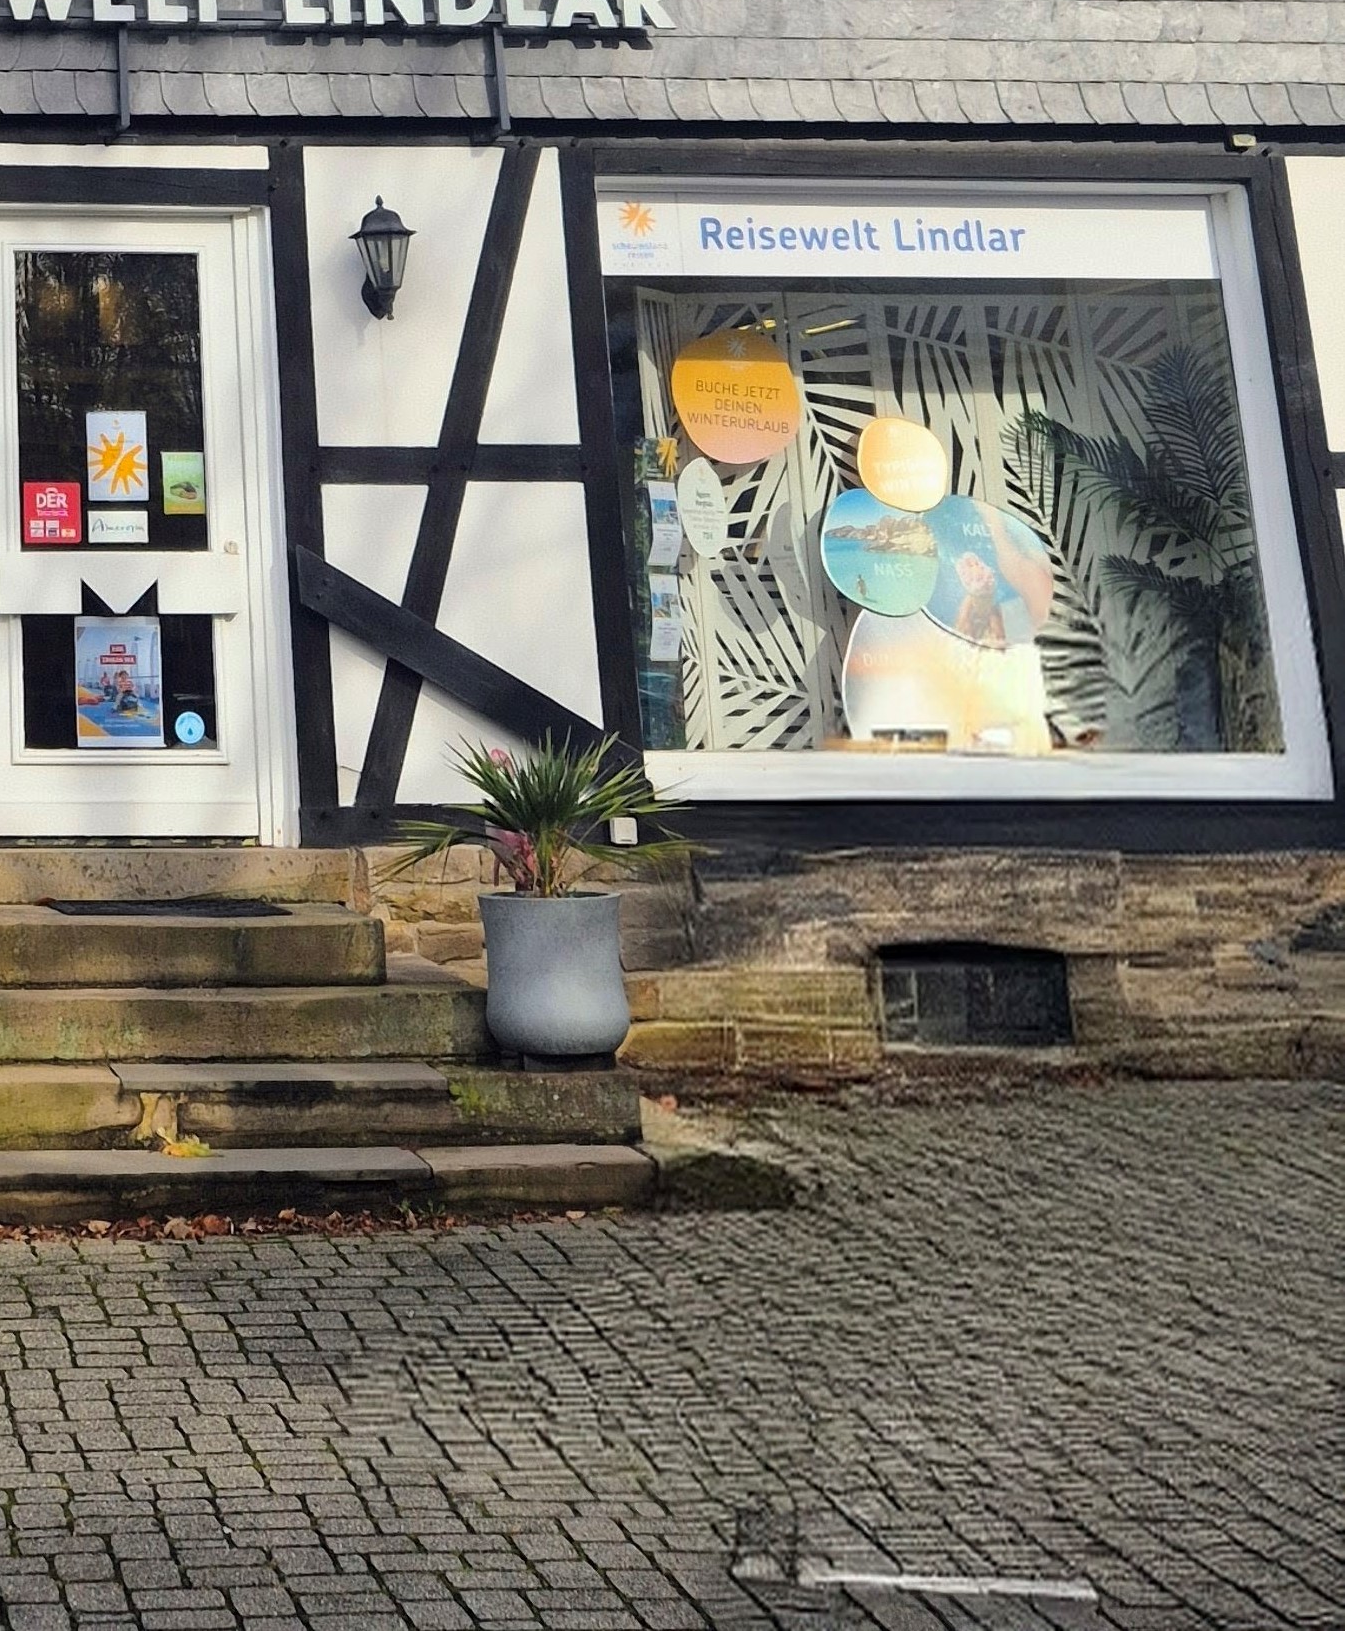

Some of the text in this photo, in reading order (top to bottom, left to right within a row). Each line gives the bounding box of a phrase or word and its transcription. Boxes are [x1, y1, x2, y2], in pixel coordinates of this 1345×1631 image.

[699, 216, 1026, 254] Reisewelt Lindlar
[695, 379, 781, 400] BUCHE JETZT
[714, 398, 763, 414] DEINEN
[687, 411, 790, 435] WINTERURLAUB
[36, 492, 68, 509] DER
[873, 562, 913, 577] NASS
